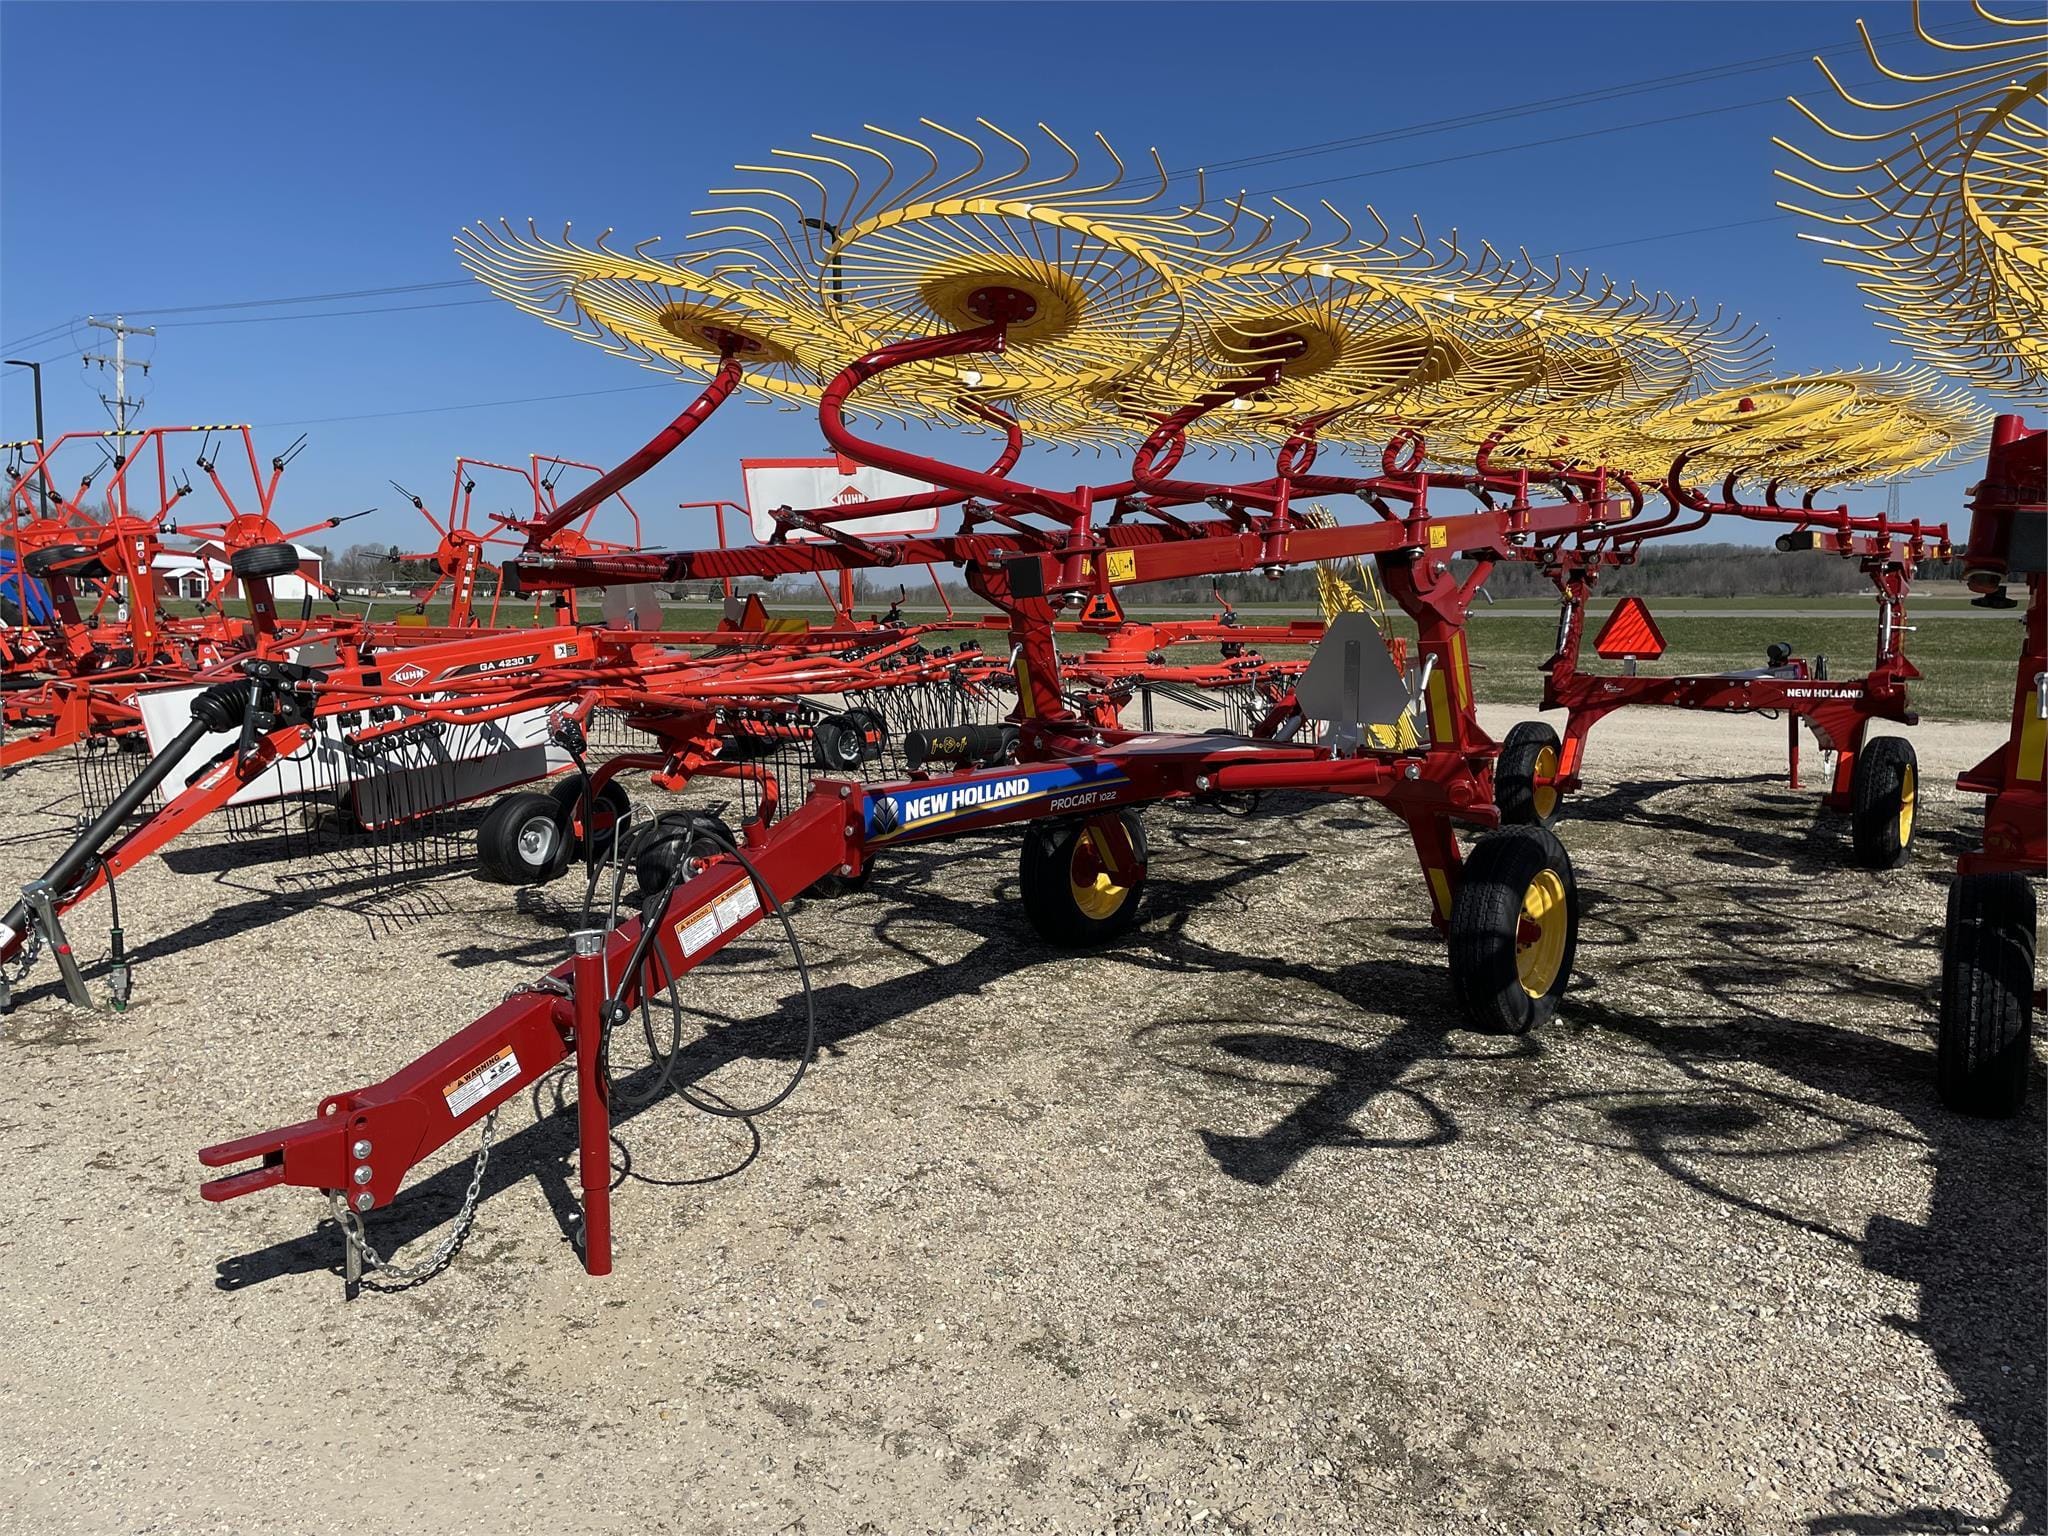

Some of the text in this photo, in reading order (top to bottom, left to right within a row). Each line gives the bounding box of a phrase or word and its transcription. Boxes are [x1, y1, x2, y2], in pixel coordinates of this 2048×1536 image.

[837, 493, 866, 505] KUHN
[480, 655, 534, 671] GA 4230 T
[395, 669, 424, 682] KUHN
[1786, 688, 1864, 699] NEW HOLLAND
[905, 778, 1030, 822] NEW HOLLAND
[1050, 790, 1117, 812] PROCART 1022
[685, 908, 709, 926] WARNING
[463, 1054, 501, 1081] WARNING
